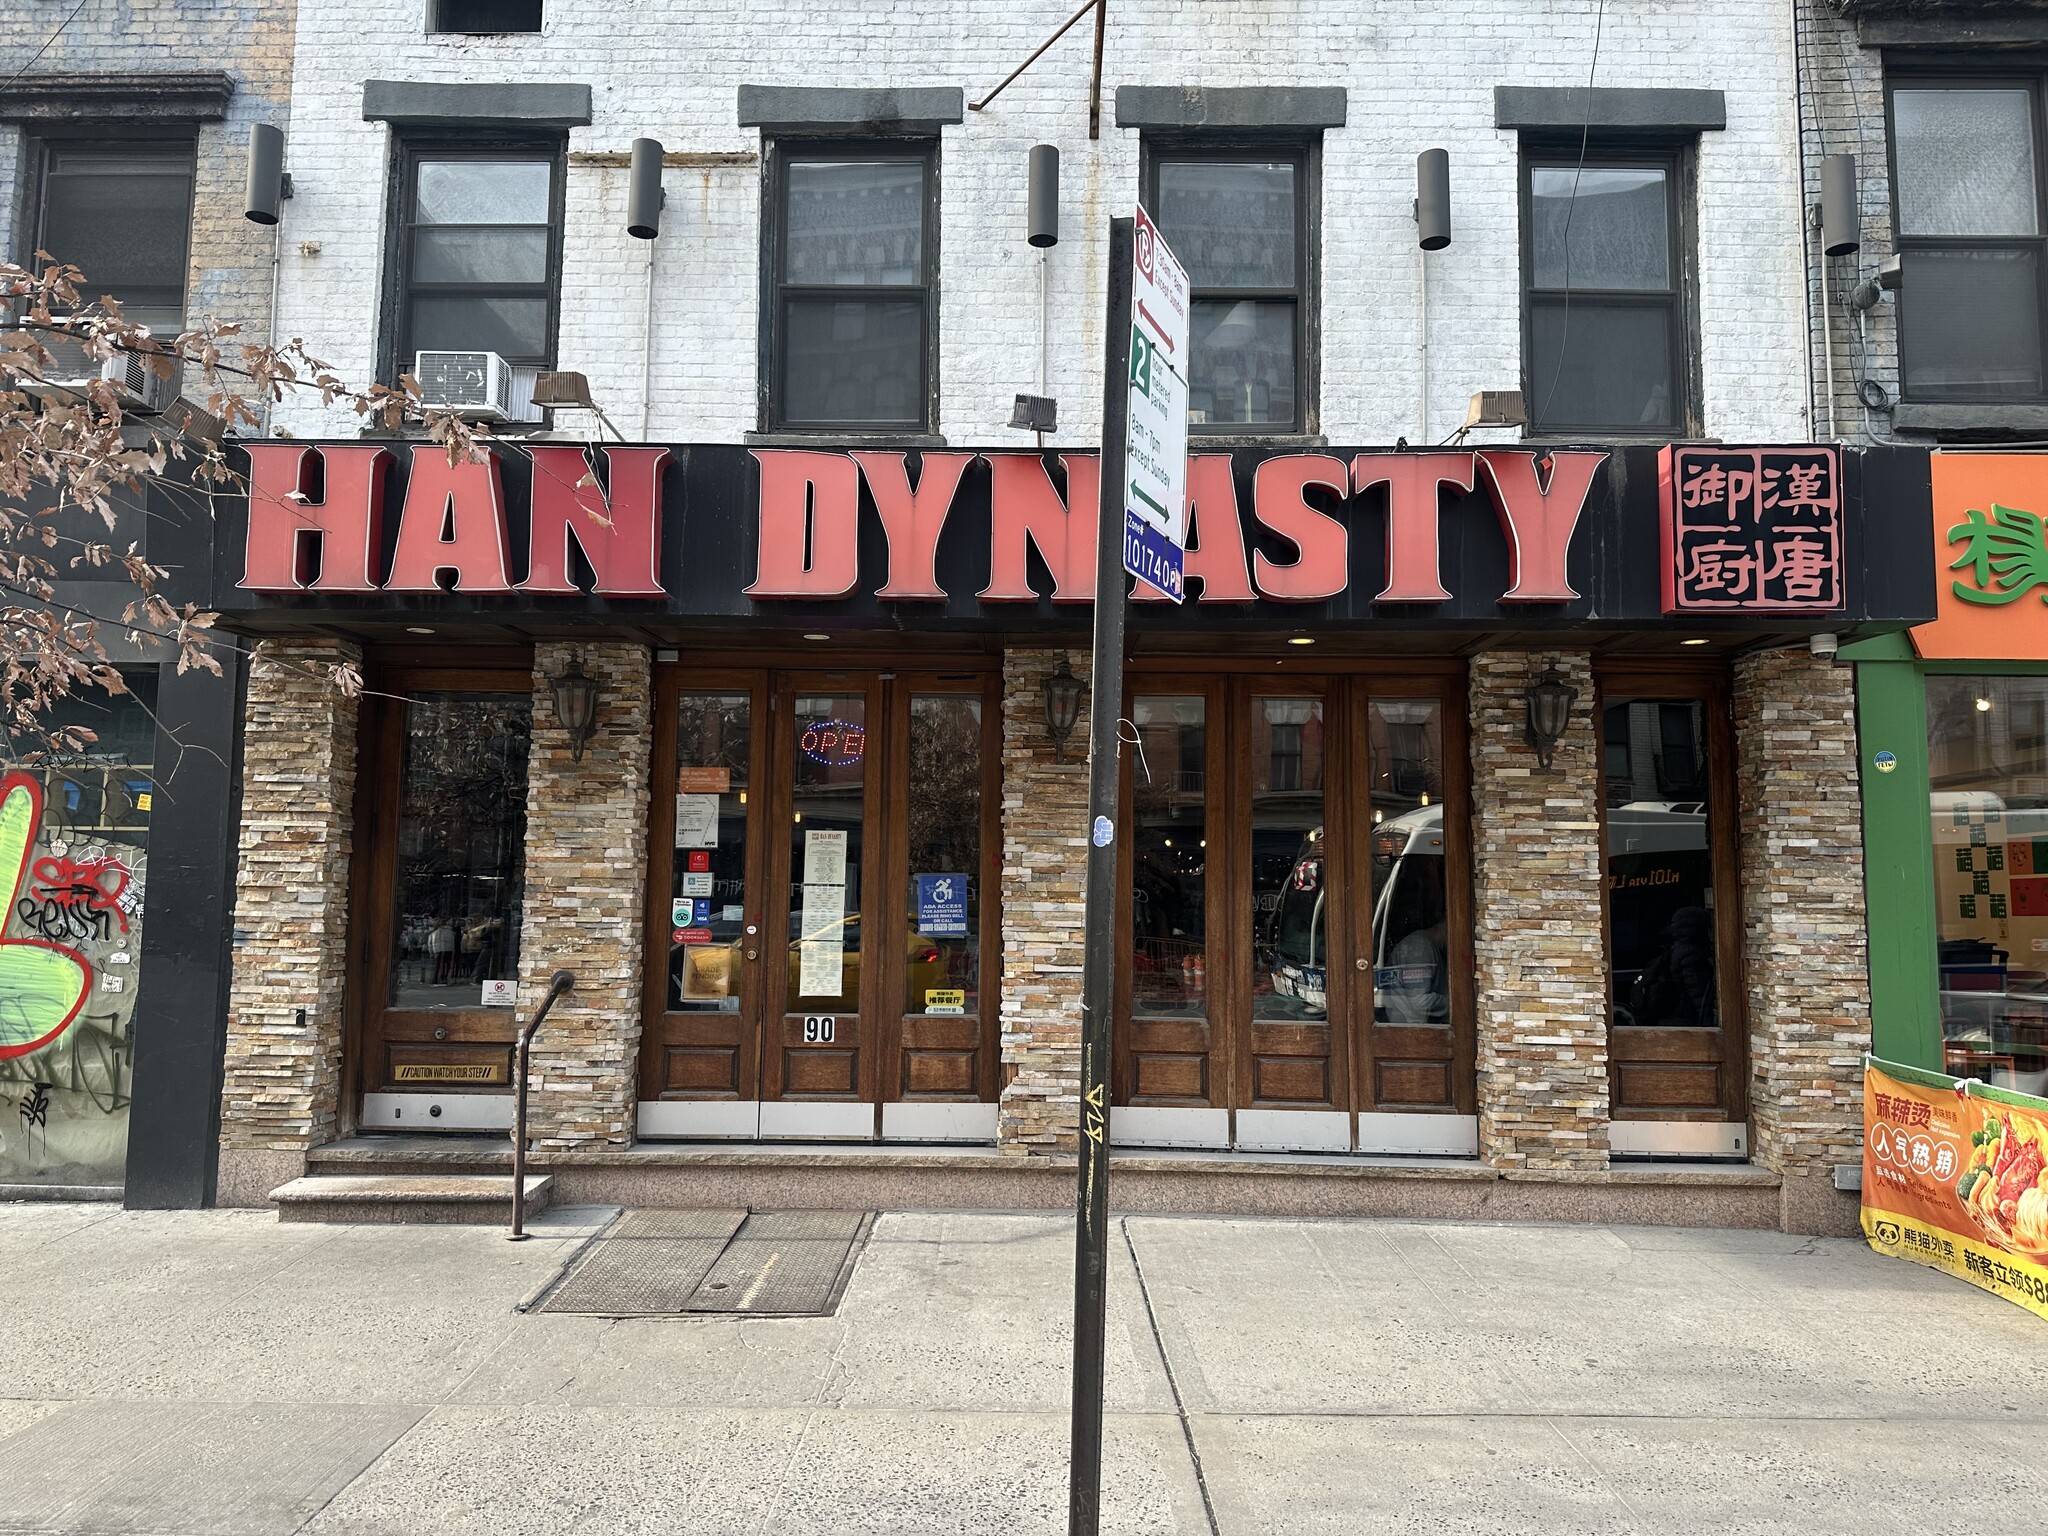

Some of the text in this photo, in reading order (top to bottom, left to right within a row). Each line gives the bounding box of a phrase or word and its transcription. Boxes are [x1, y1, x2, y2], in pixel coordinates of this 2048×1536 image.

[1155, 269, 1184, 321] Except Sunday
[1135, 337, 1147, 387] 2
[1150, 393, 1168, 421] parking
[1151, 375, 1171, 403] metered
[1131, 413, 1144, 439] 8am
[1149, 429, 1161, 455] 7pm
[1130, 439, 1171, 492] Except Sunday
[235, 443, 1611, 603] HAN DYNASTY
[1127, 534, 1170, 588] 101740
[928, 996, 962, 1004] 推荐餐厅
[805, 1018, 834, 1042] 90
[410, 1067, 483, 1078] CAUTION WATCH YOUR STEP
[1875, 1093, 1932, 1131] 麻辣烫
[1876, 1129, 1954, 1176] 人气热销
[1904, 1226, 1955, 1258] 熊猫外卖
[1963, 1247, 2048, 1305] 新客立领$8
